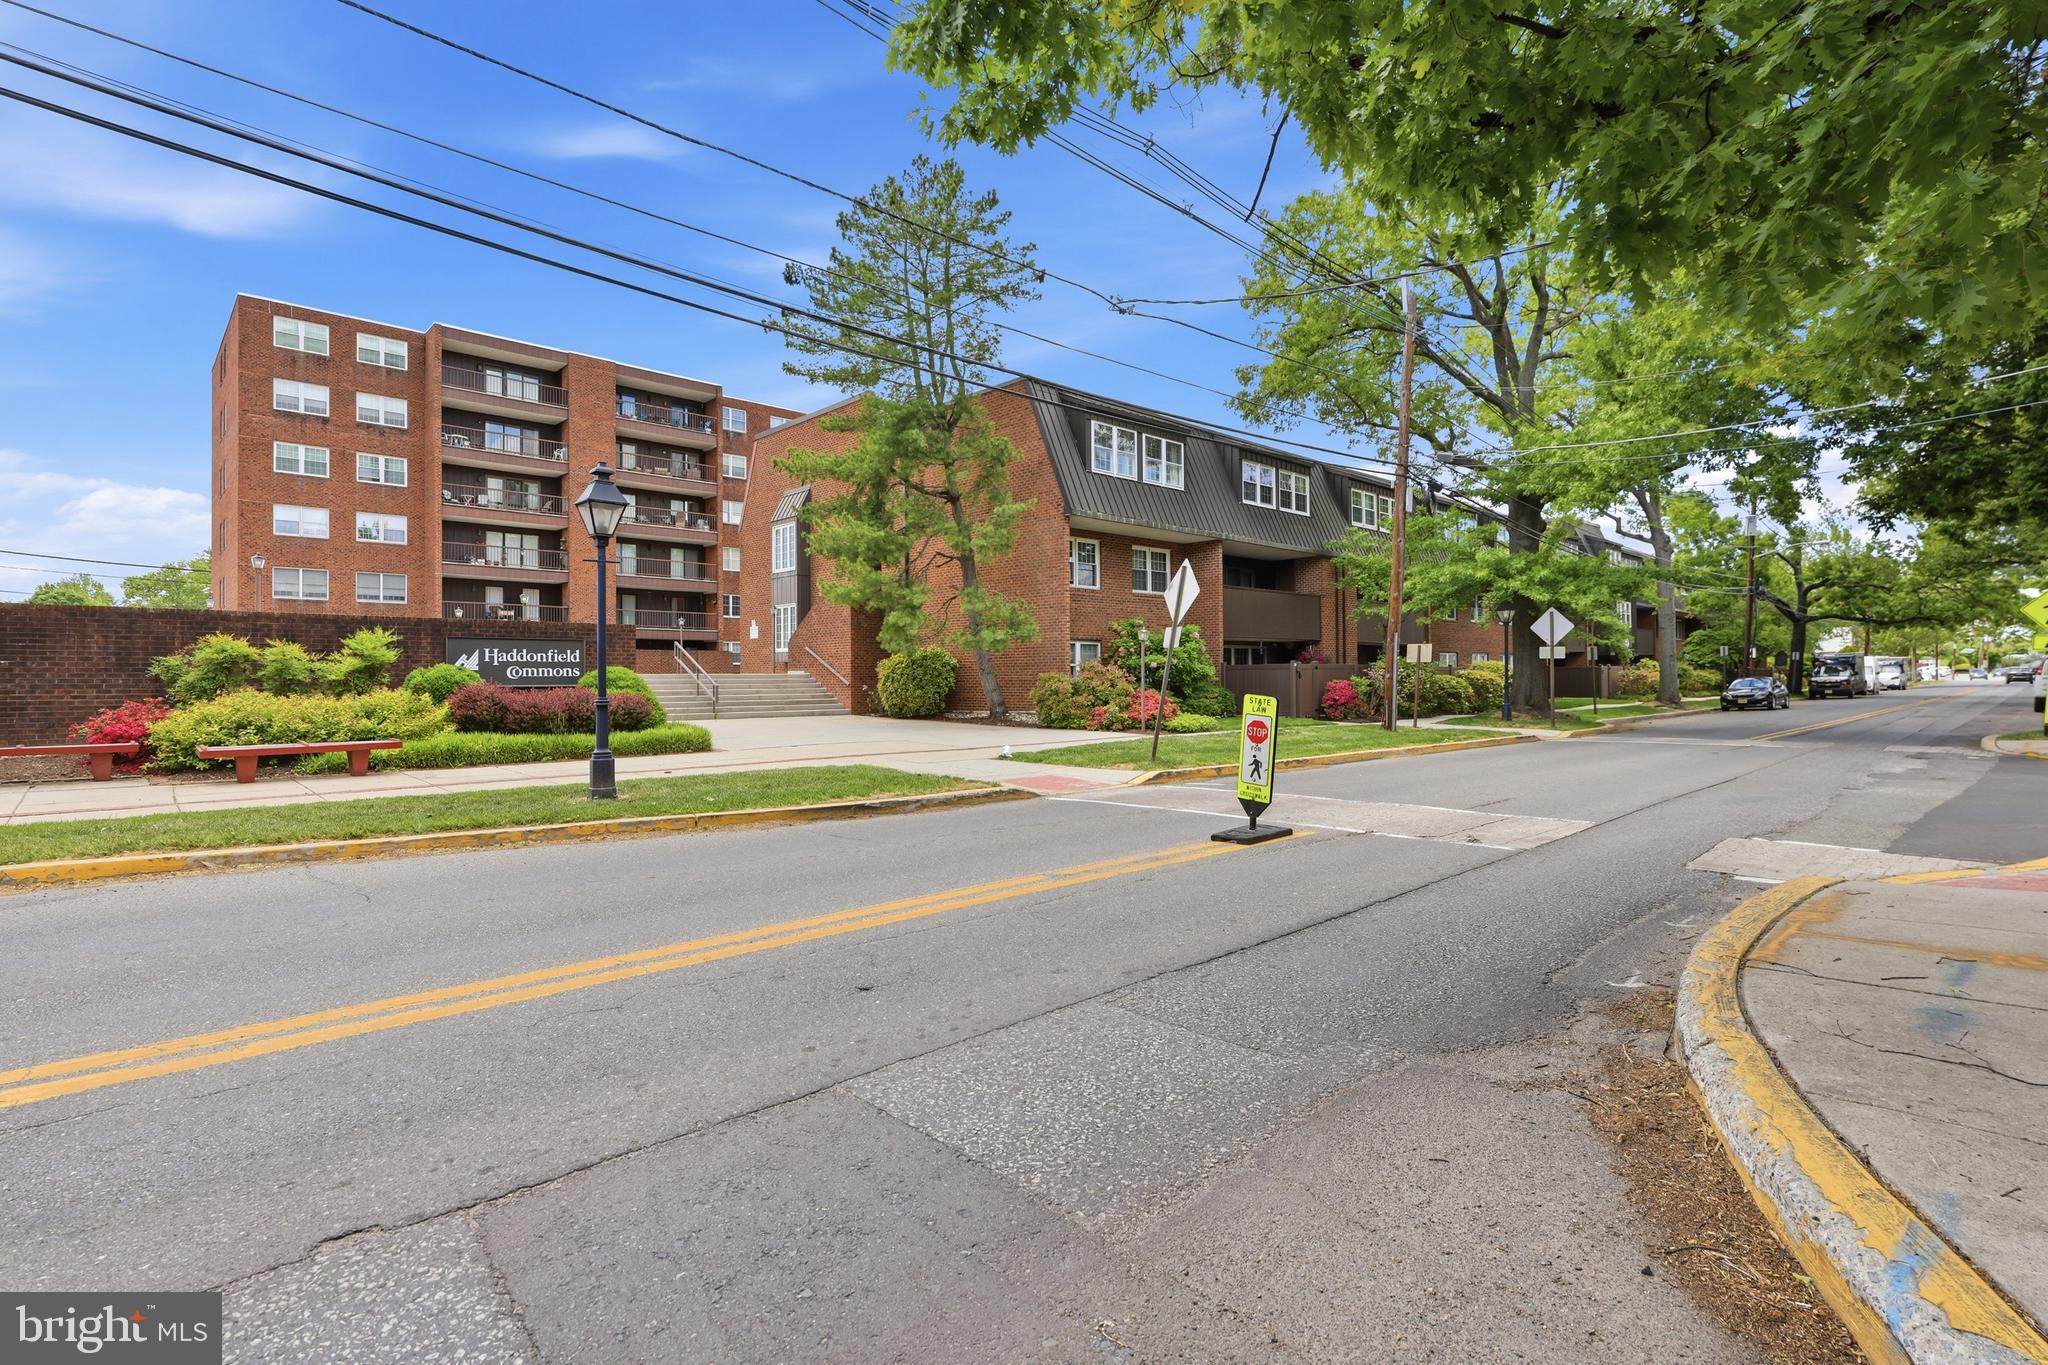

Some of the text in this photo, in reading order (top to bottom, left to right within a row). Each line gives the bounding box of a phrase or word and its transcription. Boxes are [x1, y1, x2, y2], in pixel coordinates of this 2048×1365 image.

[483, 647, 580, 665] Haddonfield
[506, 665, 580, 680] Commons
[1249, 696, 1271, 706] STATE
[1252, 705, 1267, 713] LAW
[1247, 726, 1268, 737] STOP
